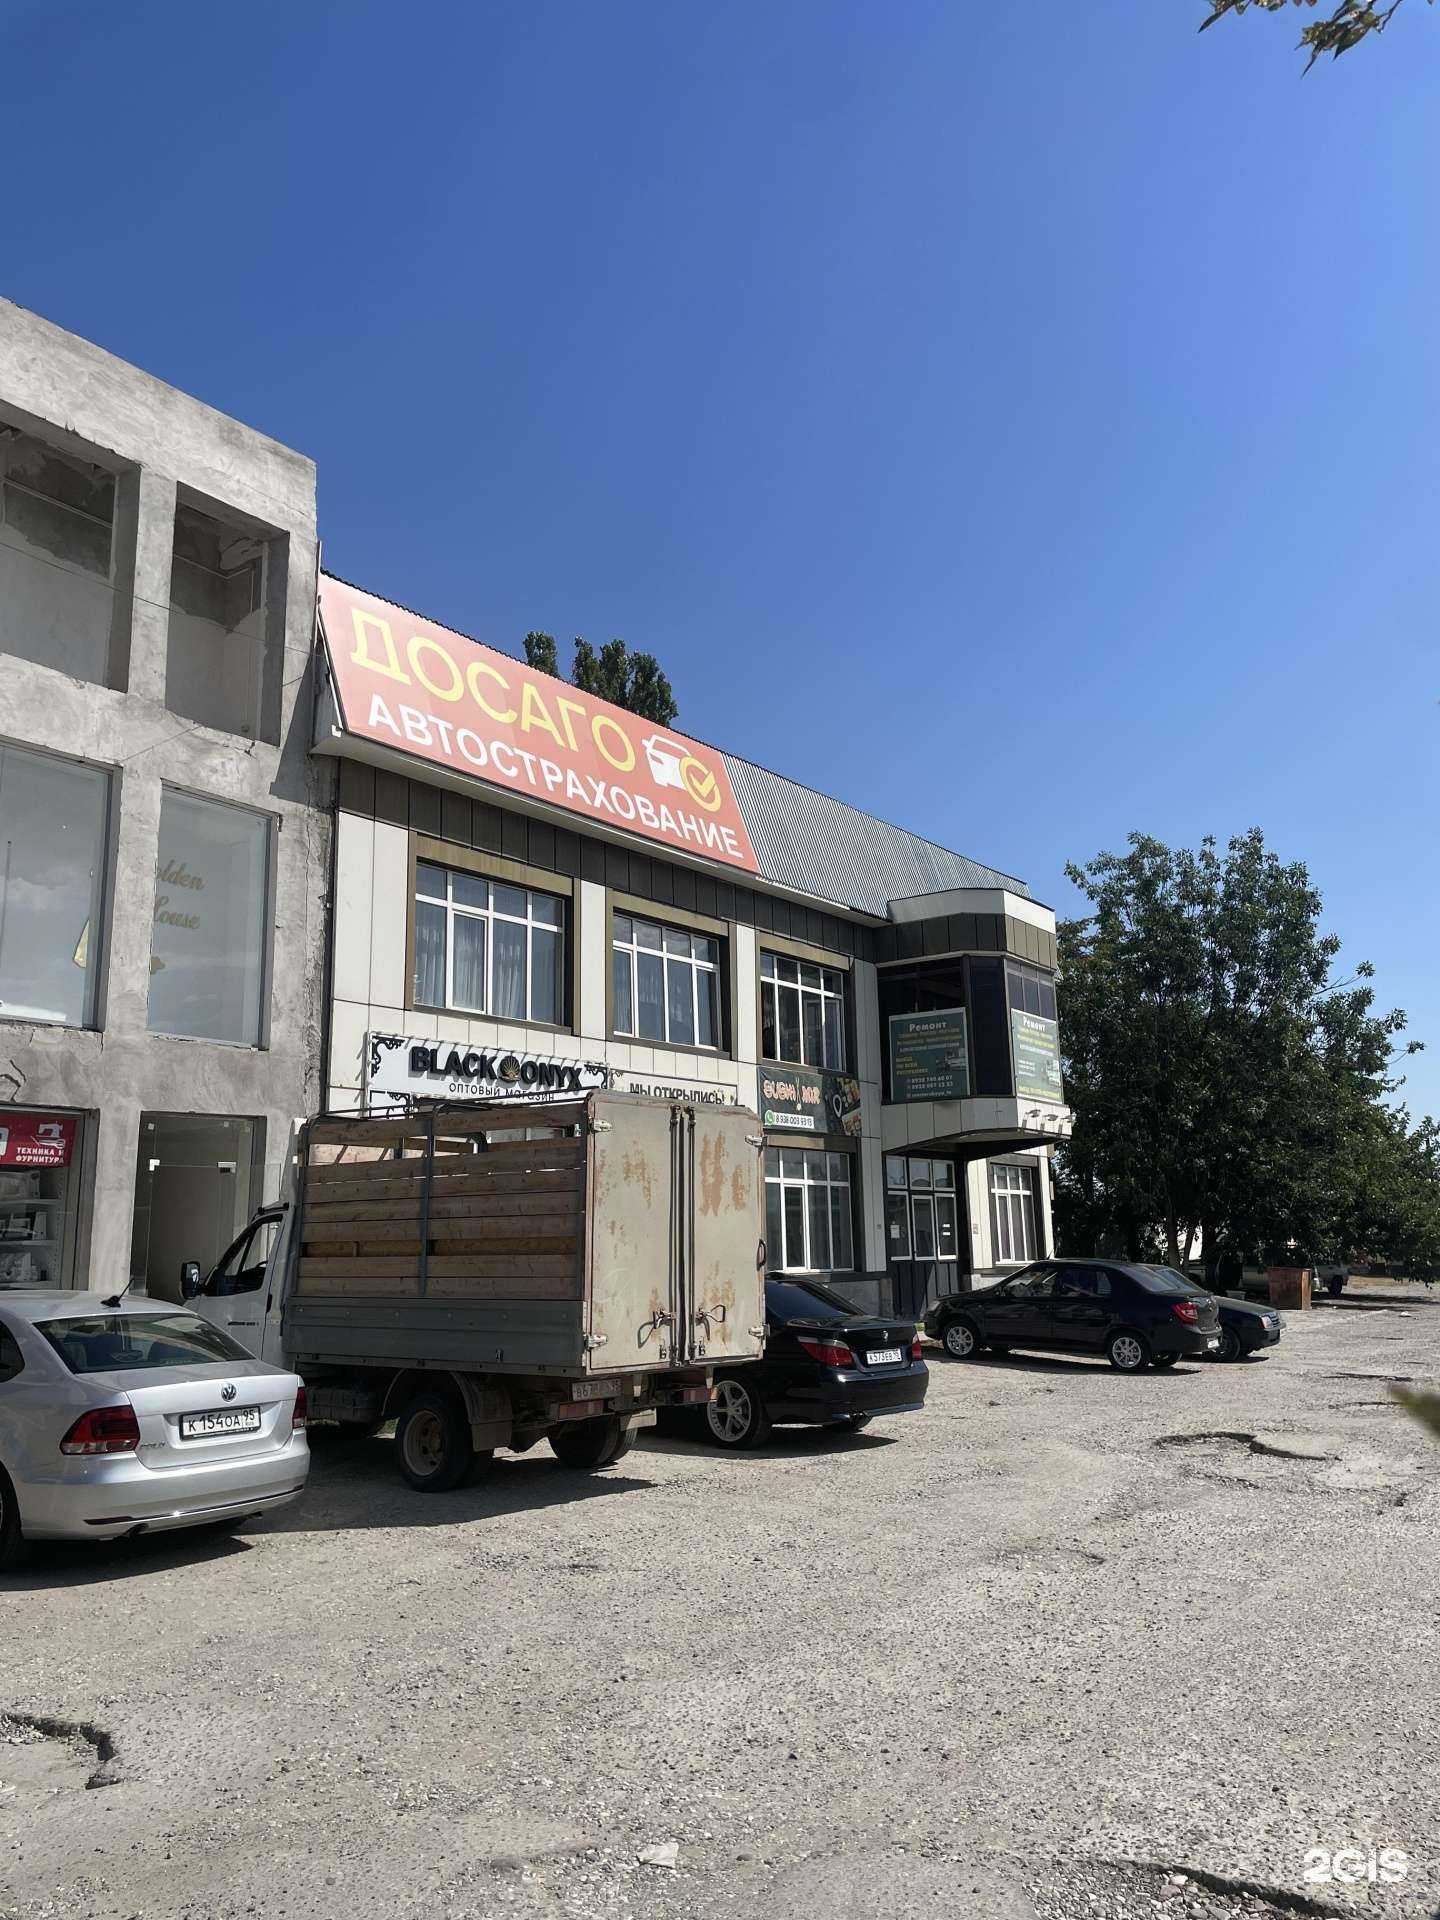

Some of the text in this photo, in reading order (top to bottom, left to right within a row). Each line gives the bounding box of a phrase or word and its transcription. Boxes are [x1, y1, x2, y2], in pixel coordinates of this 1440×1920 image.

[351, 608, 636, 773] ДОСАГО
[368, 693, 744, 859] АВТОСТРАХОВАНИЕ
[157, 859, 206, 891] lden
[410, 1046, 583, 1090] BLACK ONYX
[449, 1082, 500, 1097] ОПТОВЫЙ
[629, 1083, 651, 1096] МЫ
[15, 1155, 65, 1164] ФУРНИТУРА
[17, 1147, 55, 1156] ТЕХНИКА
[188, 1409, 255, 1433] К154ОА 95
